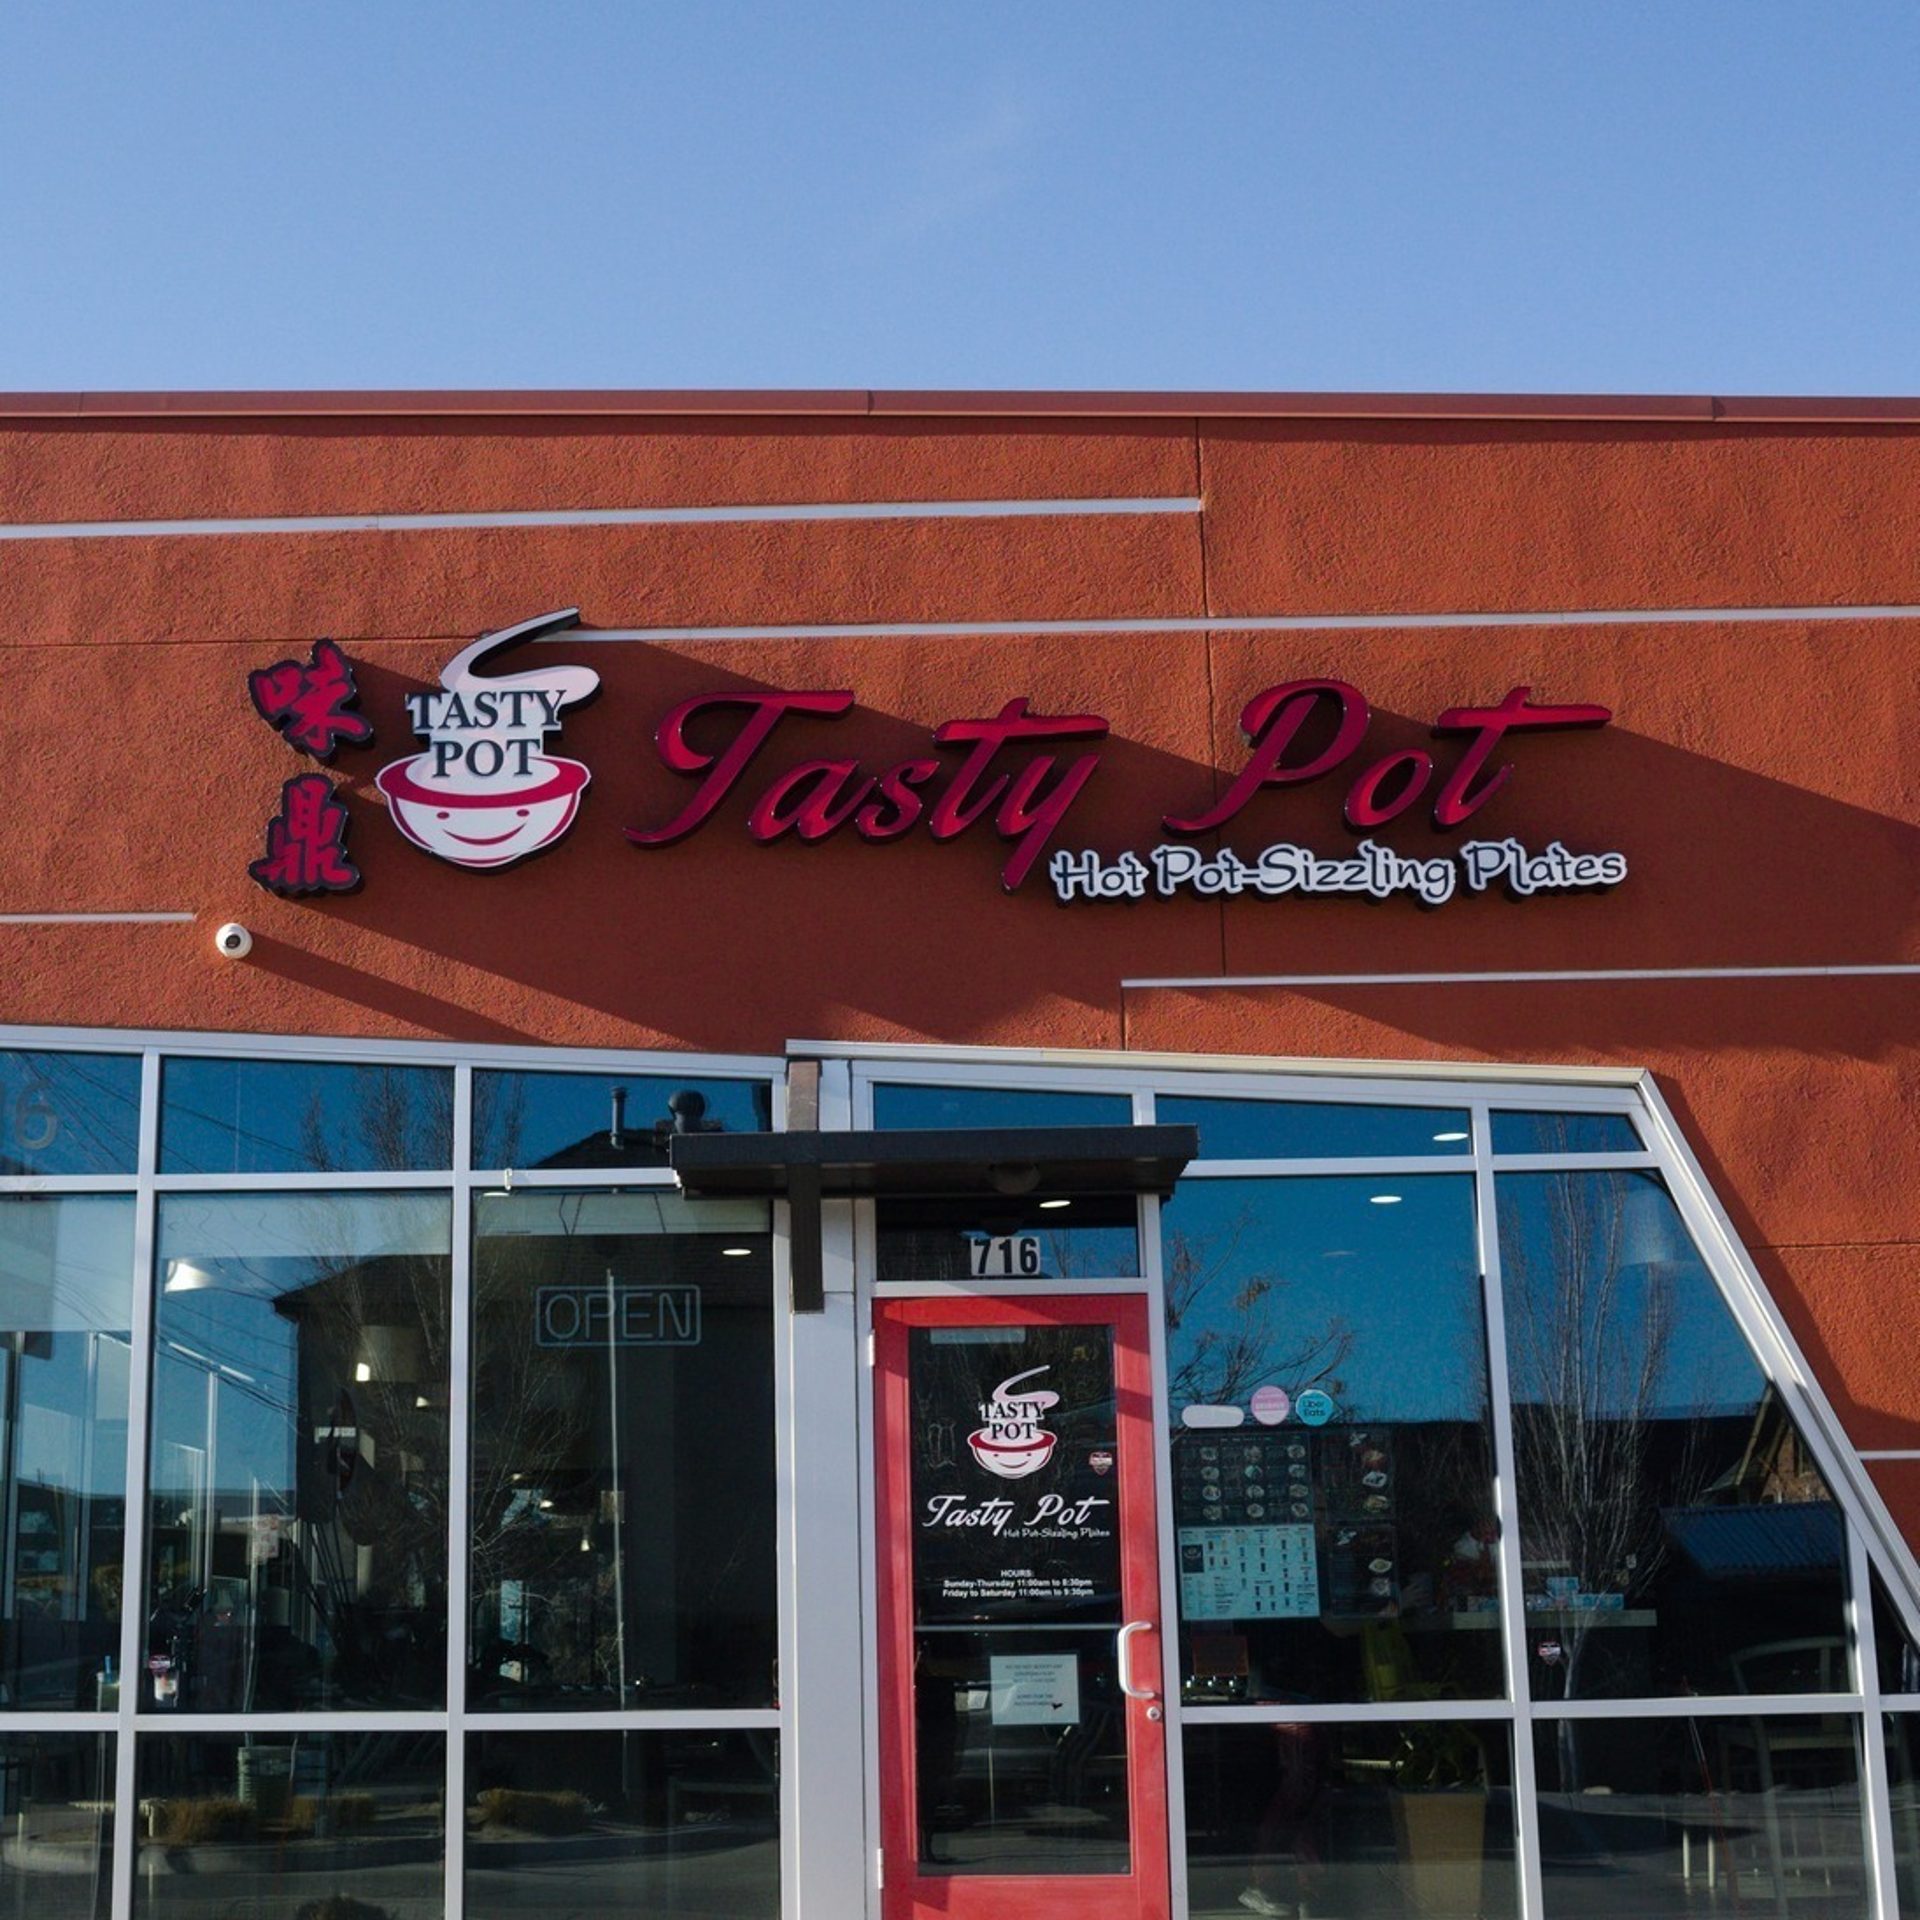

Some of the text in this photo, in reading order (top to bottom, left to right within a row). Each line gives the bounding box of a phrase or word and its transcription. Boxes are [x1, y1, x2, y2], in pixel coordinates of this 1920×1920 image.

[407, 690, 567, 729] TASTY
[432, 738, 541, 777] POT
[623, 678, 1612, 892] Tasty Pot
[1052, 850, 1148, 900] Hot
[1460, 838, 1627, 897] Plates
[974, 1238, 1038, 1275] 716
[545, 1292, 691, 1339] OPEN
[978, 1401, 1045, 1418] TASTY
[991, 1423, 1036, 1440] POT
[922, 1494, 1110, 1536] Tasty Pot
